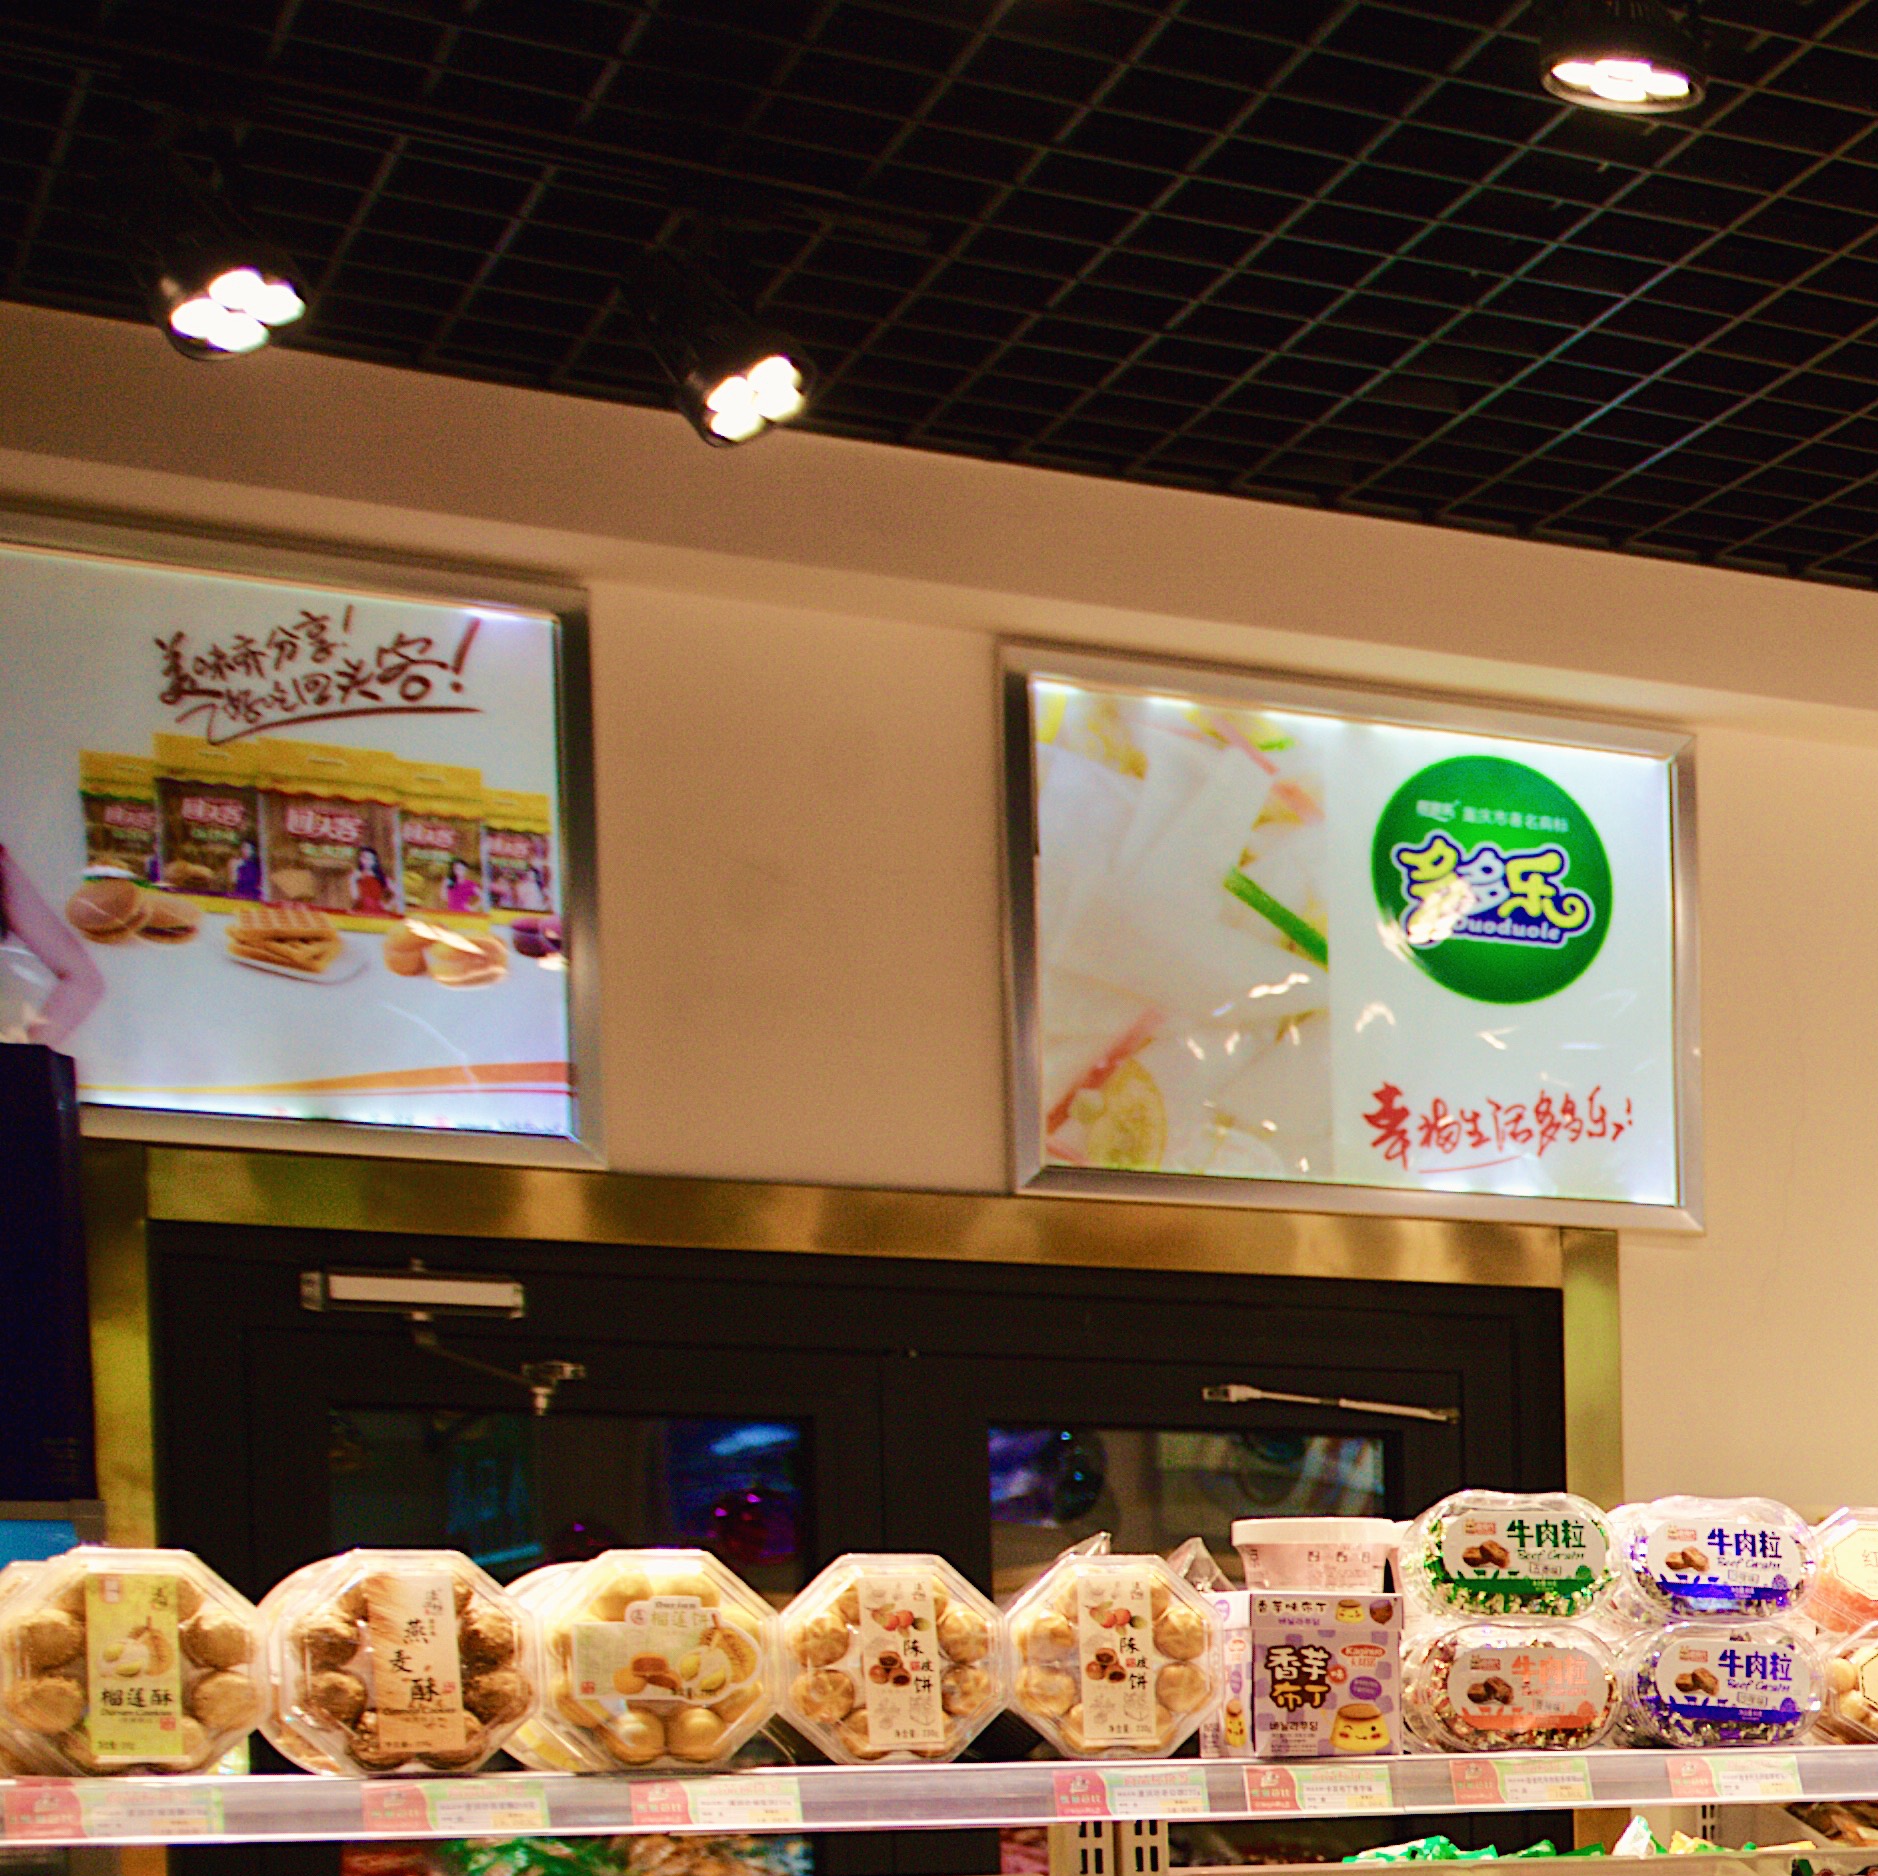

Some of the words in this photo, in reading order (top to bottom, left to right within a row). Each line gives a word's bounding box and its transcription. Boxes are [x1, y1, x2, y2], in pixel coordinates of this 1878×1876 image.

[1506, 1518, 1587, 1549] 牛肉粒
[1707, 1528, 1784, 1559] 牛肉粒
[1267, 1645, 1330, 1682] 香芋
[1511, 1655, 1591, 1687] 牛肉粒
[1718, 1649, 1793, 1682] 牛肉粒
[1272, 1683, 1330, 1711] 布丁
